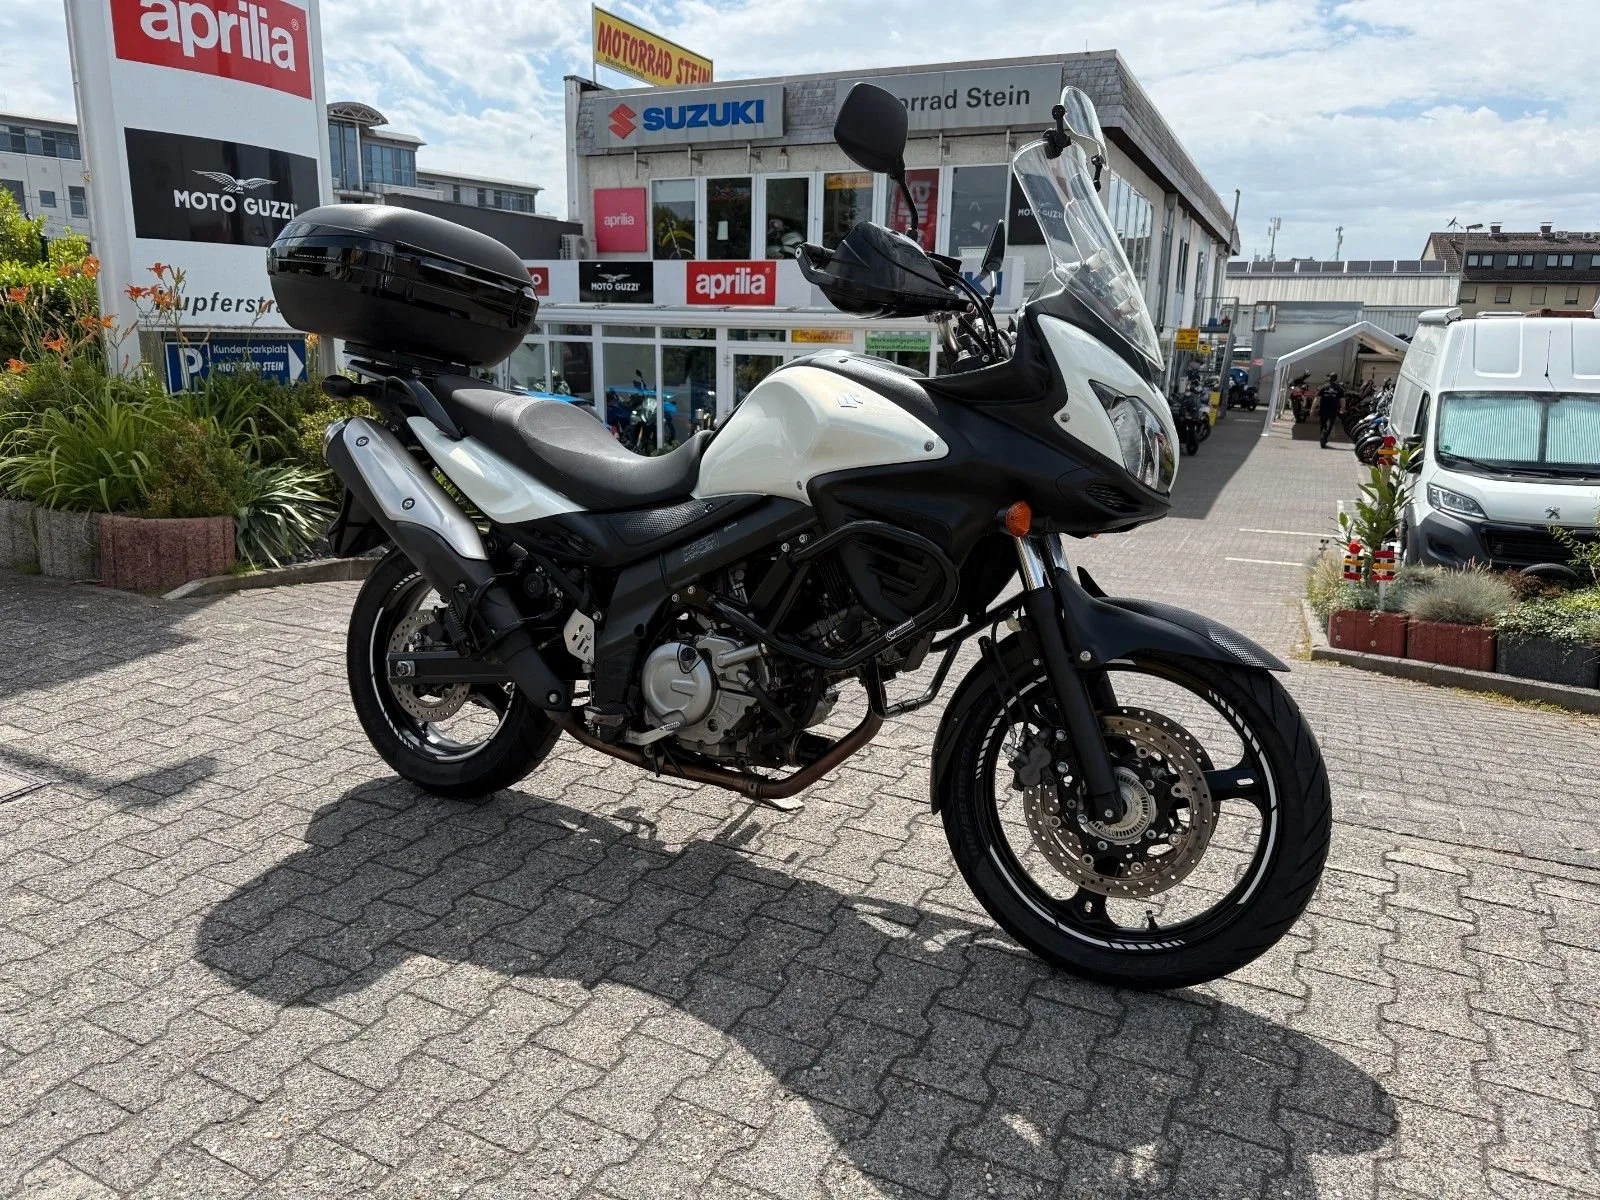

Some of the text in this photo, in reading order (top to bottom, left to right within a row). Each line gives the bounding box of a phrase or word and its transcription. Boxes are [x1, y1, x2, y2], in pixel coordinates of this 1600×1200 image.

[140, 0, 296, 72] aprilia
[597, 20, 710, 84] MOTORRAD STEIN
[966, 85, 1030, 108] Stein
[642, 100, 764, 132] SUZUKI
[173, 189, 295, 220] MOTO GUZZI
[604, 212, 635, 228] aprilia
[591, 282, 639, 291] MOTO GUZZI
[695, 267, 766, 299] aprilia
[213, 344, 287, 355] Kundenparkplatz
[262, 361, 284, 371] STEIN
